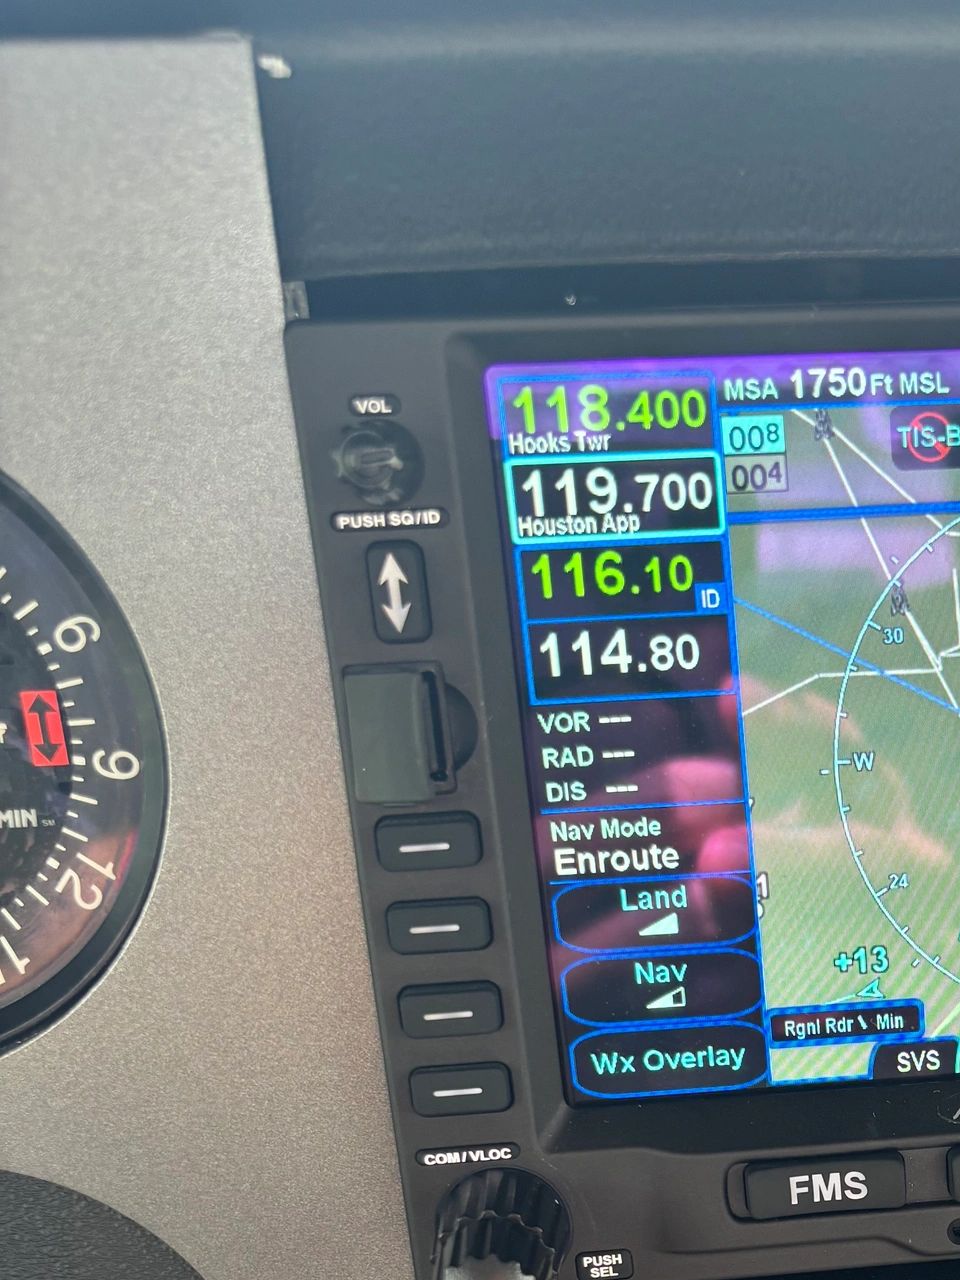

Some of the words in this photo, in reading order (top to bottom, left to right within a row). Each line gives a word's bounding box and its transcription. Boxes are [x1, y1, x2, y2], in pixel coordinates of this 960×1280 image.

[724, 377, 780, 402] MSA
[900, 370, 951, 396] MSL
[354, 397, 393, 415] VOL
[512, 382, 708, 436] 118.400
[509, 432, 571, 455] Hooks
[575, 430, 611, 451] Twr
[521, 466, 714, 520] 119.700
[336, 513, 386, 531] PUSH
[518, 515, 599, 538] Houston
[602, 513, 641, 536] App
[531, 549, 695, 601] 116.10
[700, 589, 721, 610] ID
[882, 626, 905, 645] 30
[539, 628, 700, 679] 114.80
[537, 712, 591, 735] VOR
[541, 746, 595, 770] RAD
[545, 782, 588, 804] DIS
[550, 820, 596, 843] Nav
[600, 816, 663, 840] Mode
[553, 842, 681, 877] Enroute
[620, 883, 689, 913] Land
[833, 945, 890, 975] +13
[634, 961, 689, 986] Nav
[783, 1017, 822, 1040] Rgnl
[875, 1011, 904, 1033] Min
[590, 1051, 637, 1076] Wx
[643, 1045, 747, 1076] Overlay
[422, 1146, 513, 1167] COM/VLOC
[788, 1170, 869, 1207] FMS
[582, 1253, 624, 1268] PUSH
[589, 1265, 620, 1279] SEL
